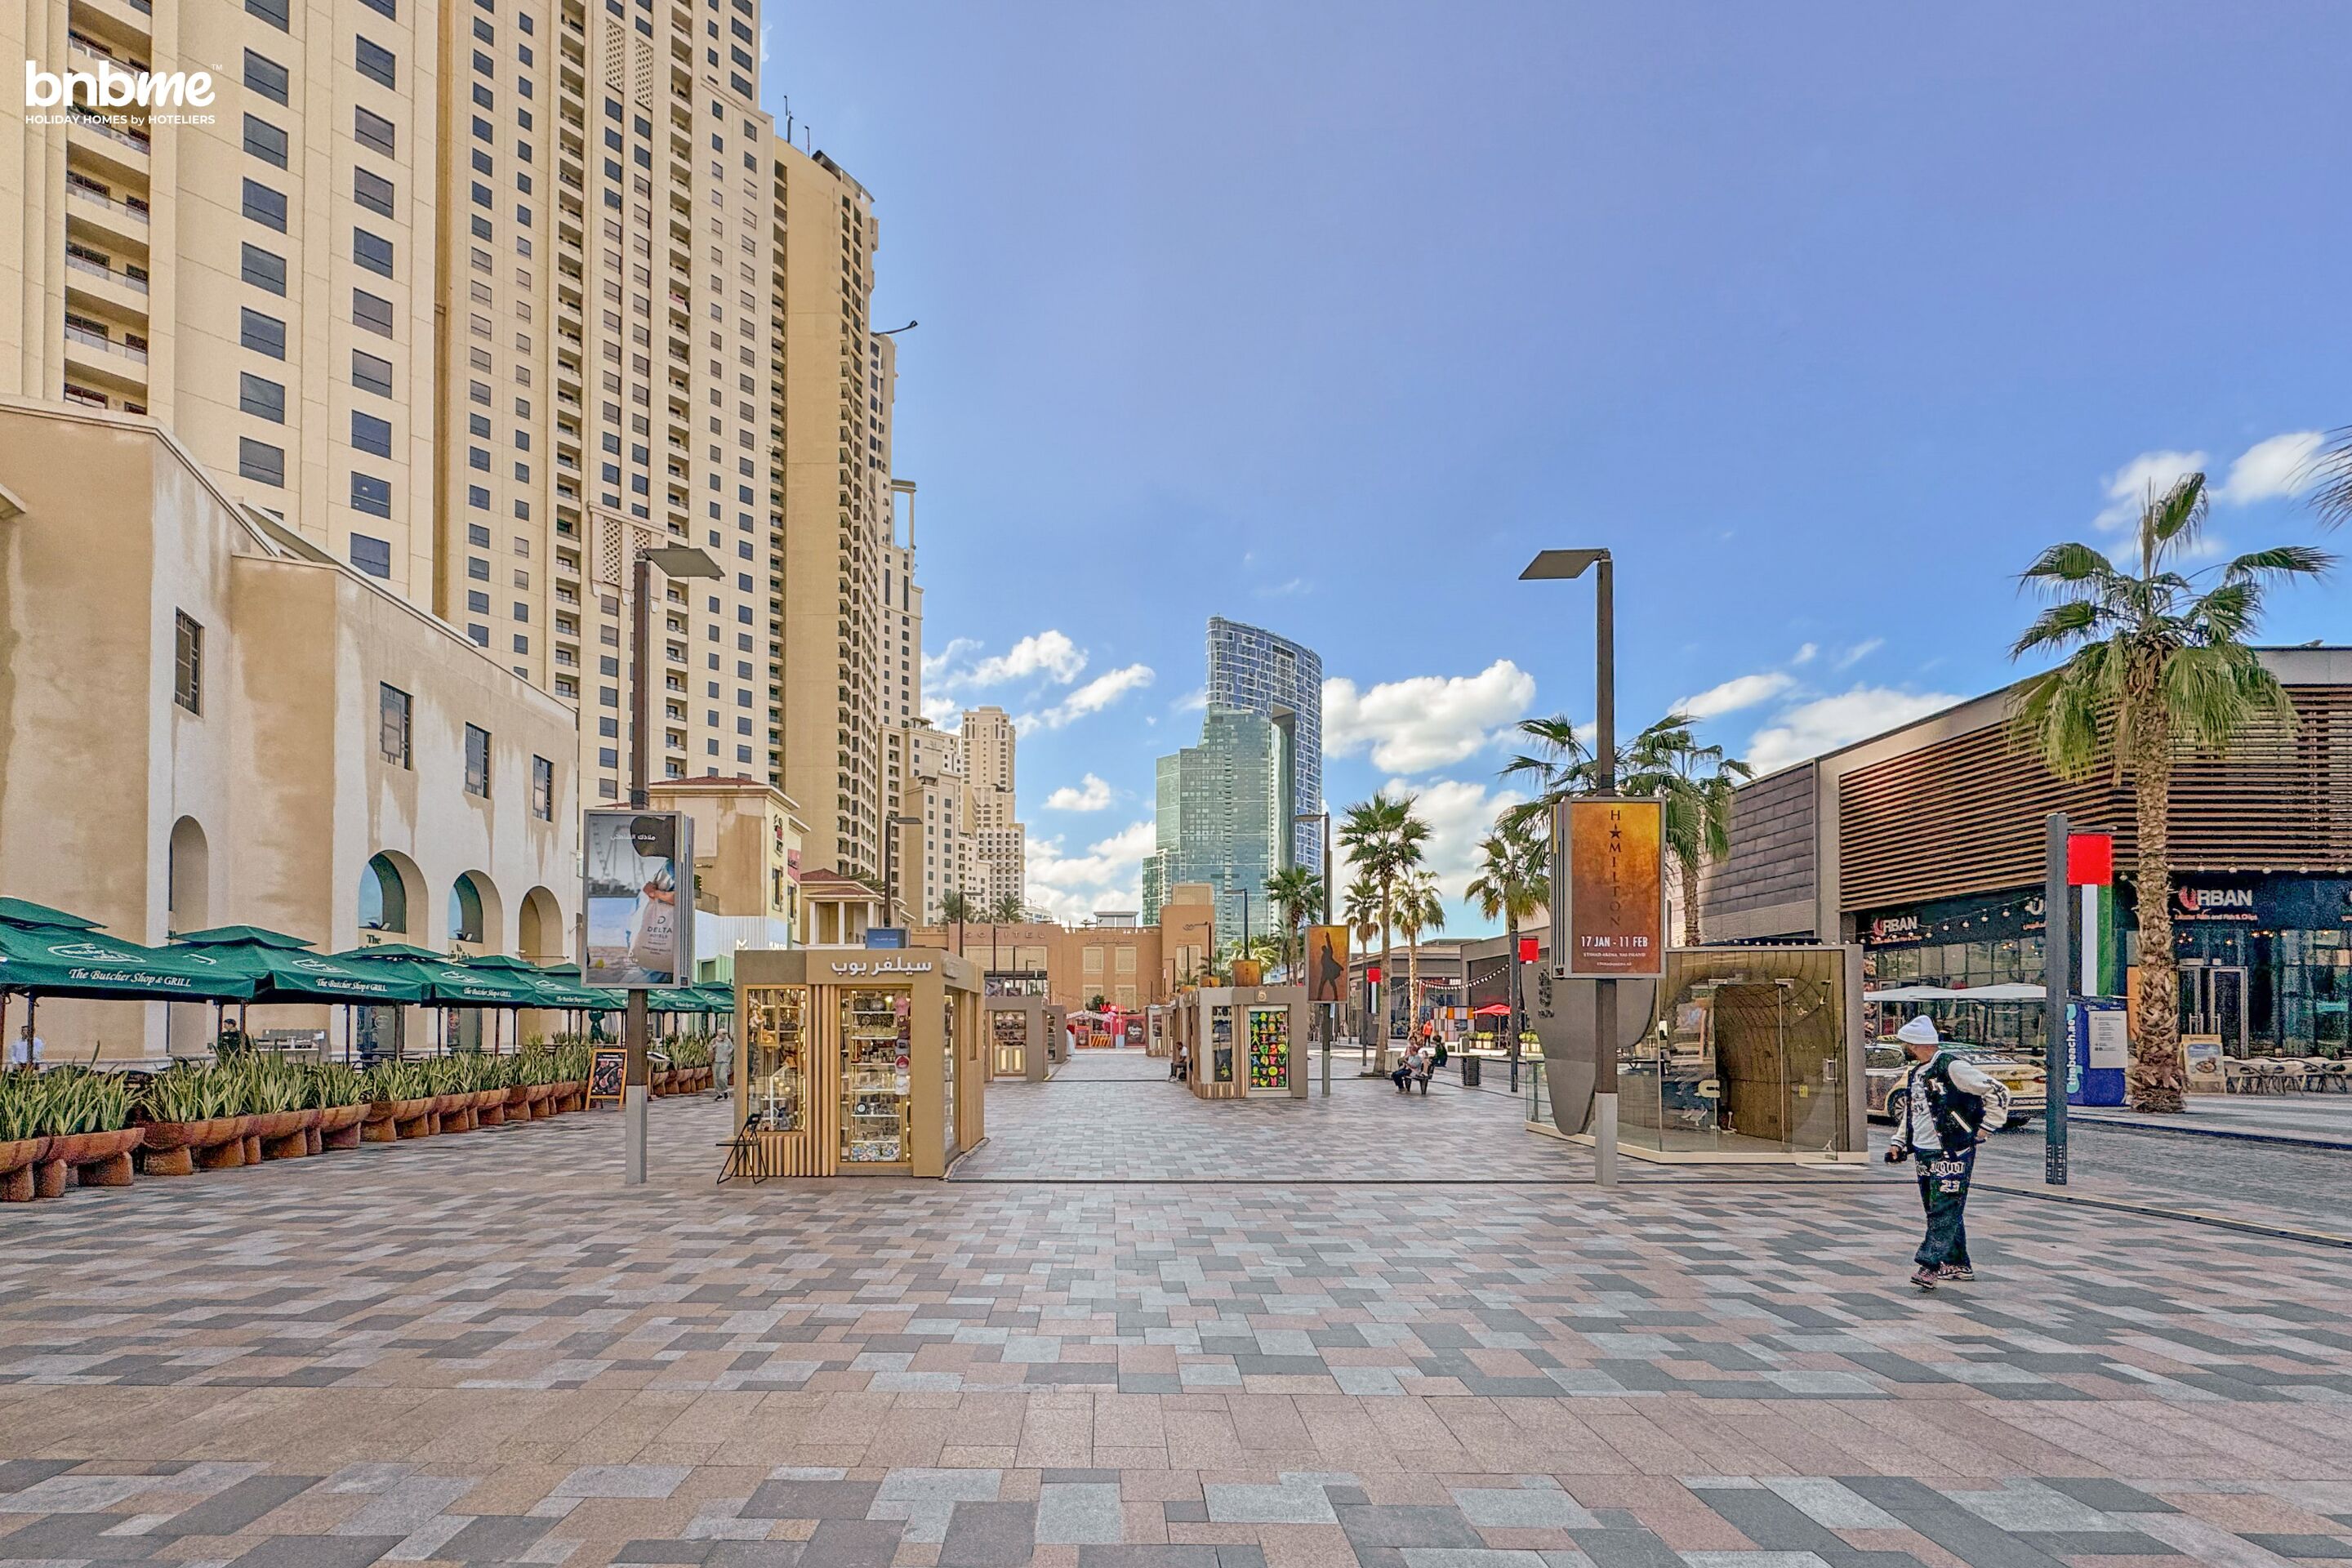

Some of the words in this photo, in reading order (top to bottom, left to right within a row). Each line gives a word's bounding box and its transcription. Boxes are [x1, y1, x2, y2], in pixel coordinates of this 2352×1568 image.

[2178, 885, 2253, 911] URBAN
[1873, 915, 1918, 937] URBAN
[1581, 936, 1592, 947] 17
[1594, 936, 1610, 947] JAN
[1619, 936, 1629, 947] 11
[1633, 936, 1648, 947] FEB
[831, 961, 867, 976] بوب
[871, 956, 932, 976] سيلفر
[69, 968, 89, 980] The
[91, 969, 131, 982] Butcher
[131, 972, 155, 987] Shop
[163, 977, 192, 987] GRILL
[328, 980, 352, 989] Butcher
[370, 983, 388, 992] GRILL
